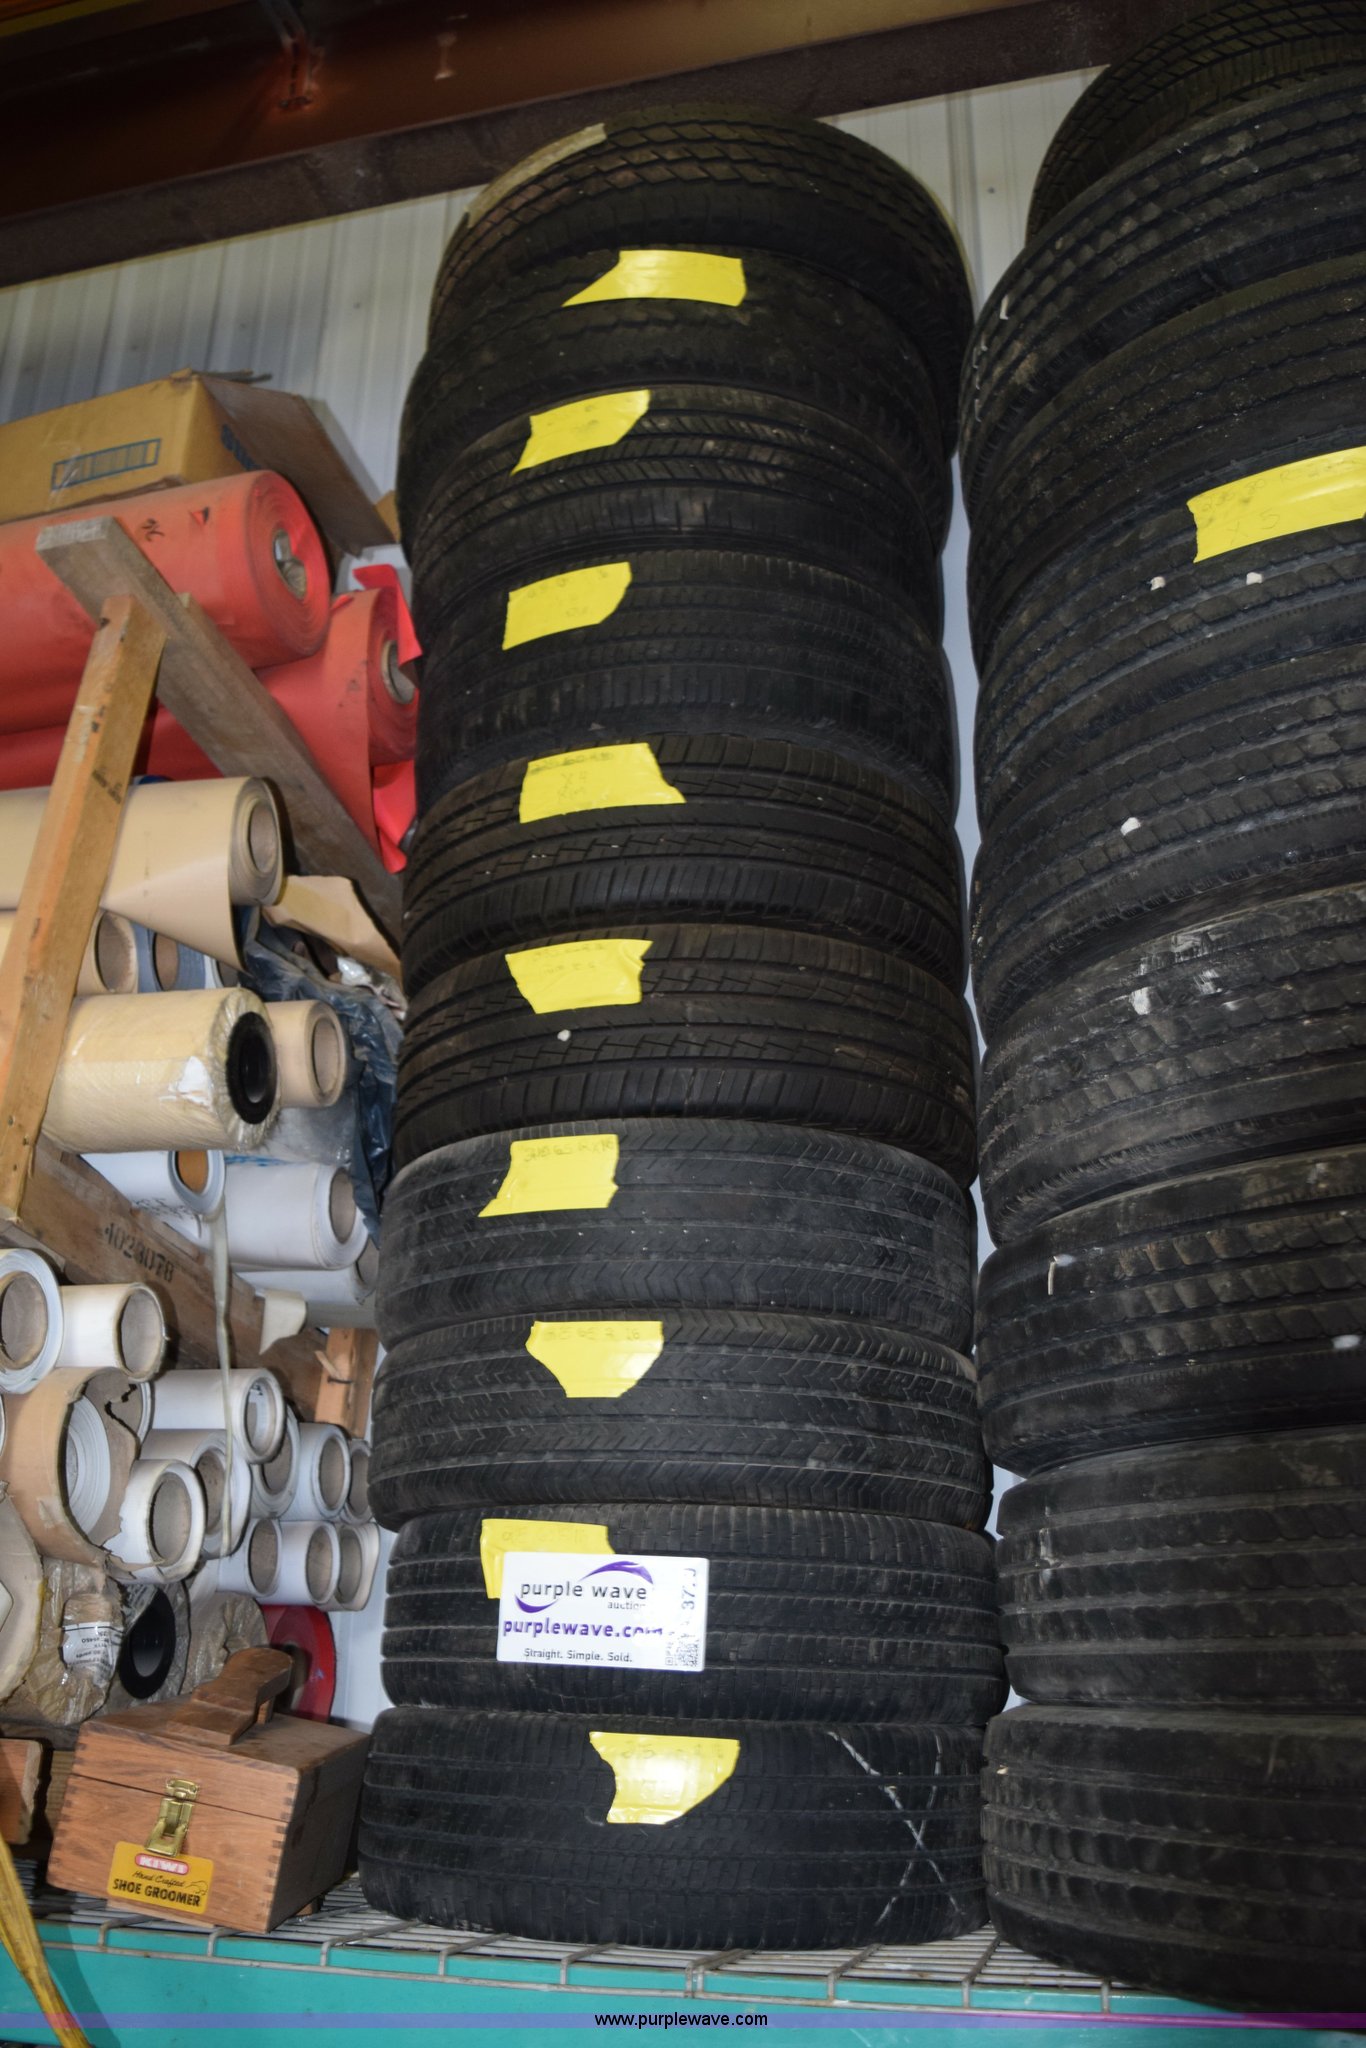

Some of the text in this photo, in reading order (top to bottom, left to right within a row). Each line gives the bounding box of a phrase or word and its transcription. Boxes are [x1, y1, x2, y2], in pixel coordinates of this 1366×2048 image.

[520, 1581, 647, 1600] purple wave
[524, 1648, 633, 1663] Straight. Simple. Sold.
[139, 1855, 185, 1875] KIWI
[113, 1879, 201, 1907] SHOE GROOMER
